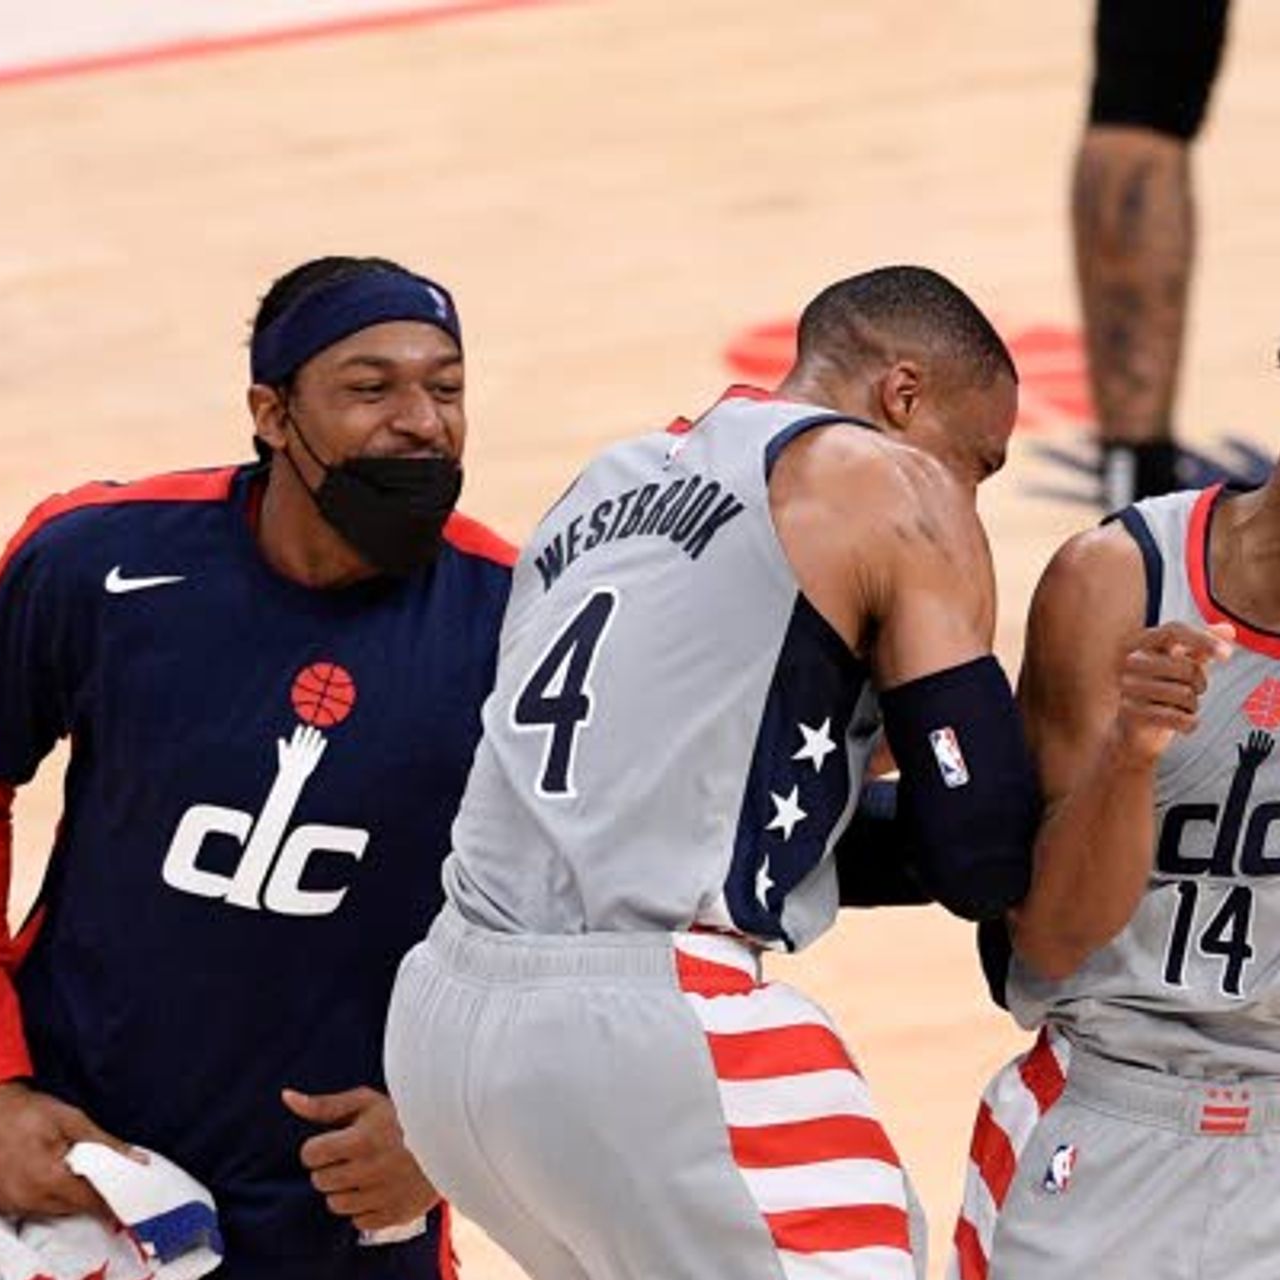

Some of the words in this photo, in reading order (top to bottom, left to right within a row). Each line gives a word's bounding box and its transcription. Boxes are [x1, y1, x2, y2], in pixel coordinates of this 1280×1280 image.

[534, 474, 745, 594] WESTBROOK
[512, 585, 620, 798] 4
[1163, 878, 1255, 997] 14
